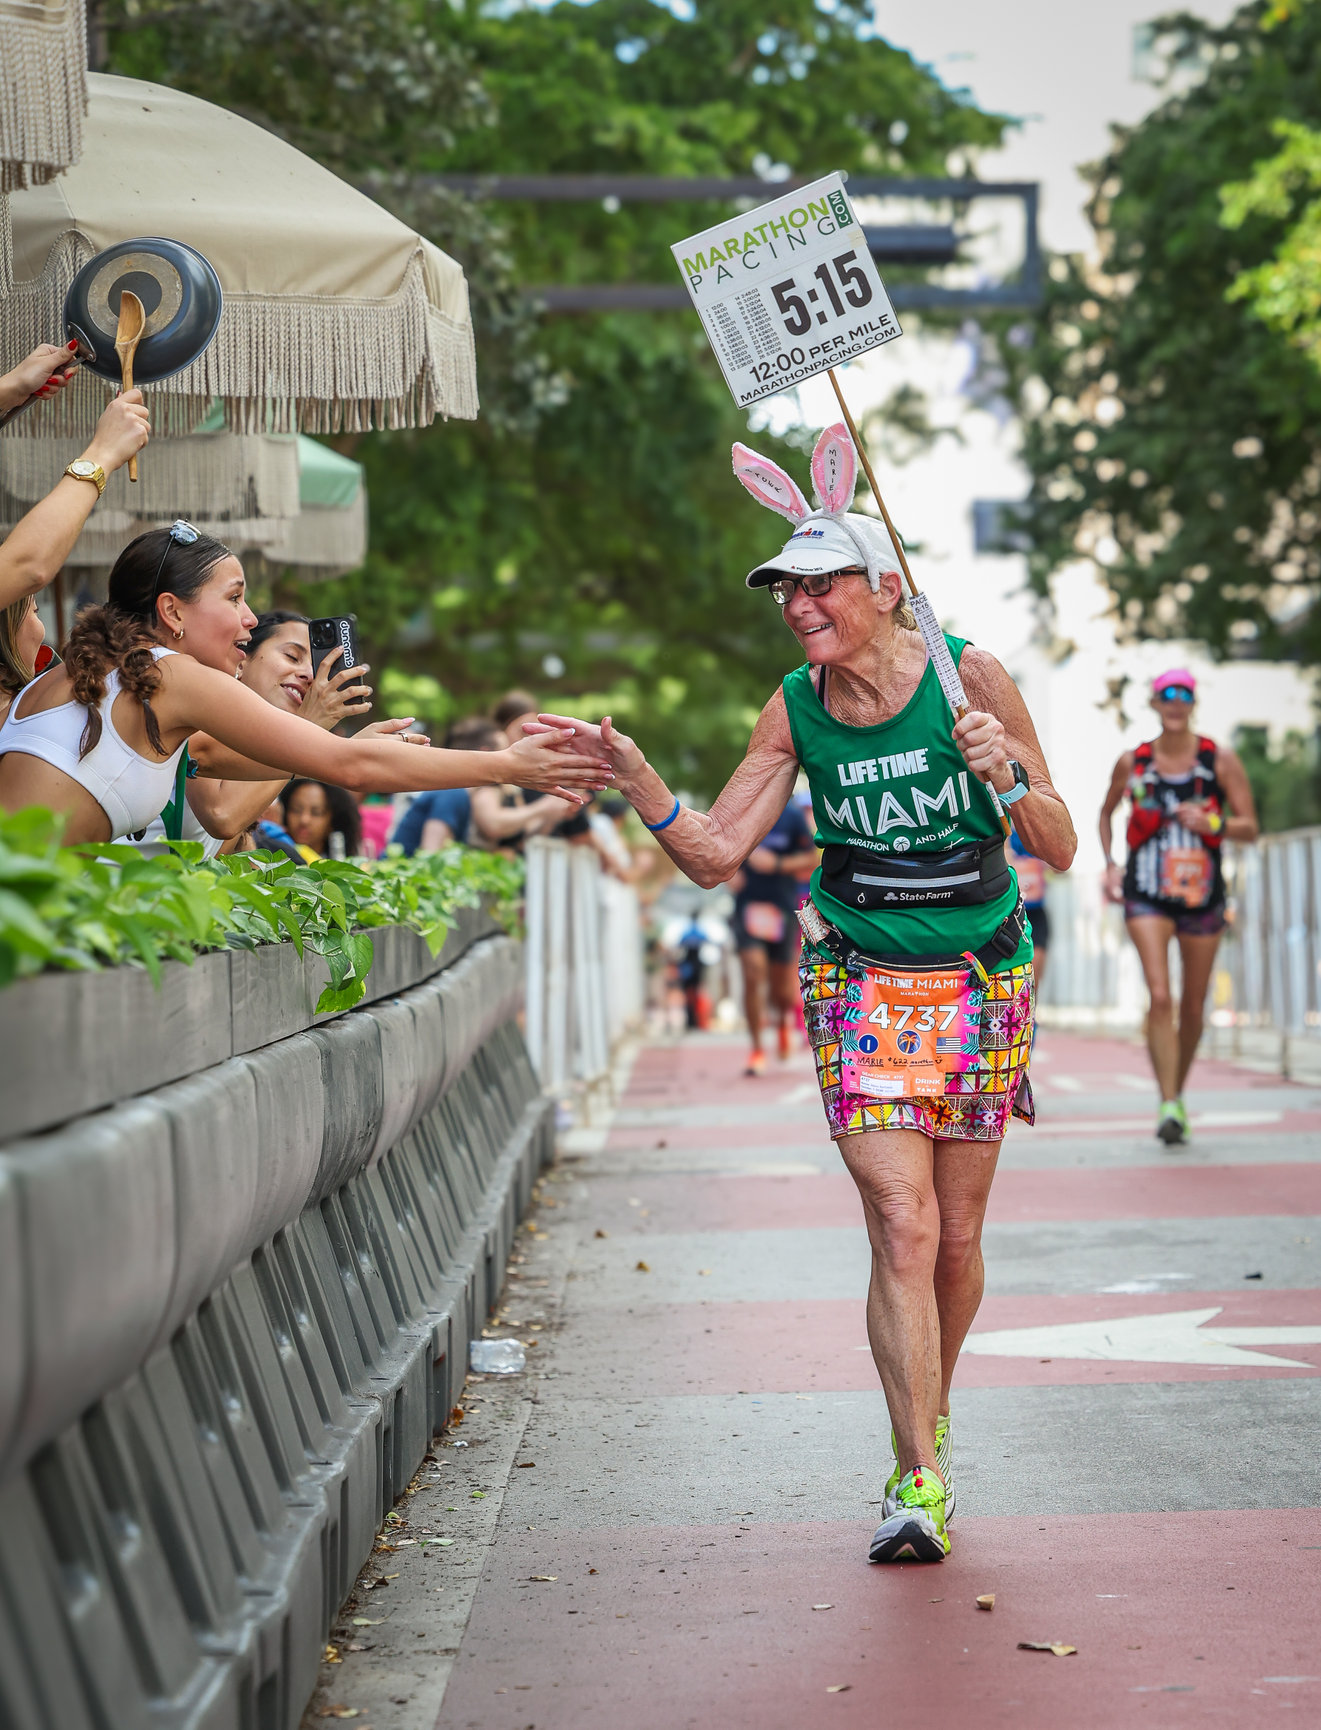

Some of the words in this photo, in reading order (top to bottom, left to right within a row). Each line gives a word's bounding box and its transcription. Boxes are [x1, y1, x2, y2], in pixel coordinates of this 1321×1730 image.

[683, 198, 829, 276] MARATHON
[690, 216, 836, 294] PACING
[771, 250, 872, 336] 5:15
[740, 327, 896, 402] MARATHONPACING.COM
[749, 347, 805, 383] 12:00
[808, 335, 846, 359] PER
[848, 314, 891, 338] MILE
[828, 449, 837, 491] MARIE
[910, 595, 928, 607] PACE
[915, 603, 930, 613] 5:15
[822, 771, 971, 837] MIAMI
[846, 837, 889, 852] MARATHON
[915, 834, 936, 846] AND
[938, 822, 959, 840] HALF
[916, 979, 958, 990] MIAMI
[867, 1002, 960, 1032] 4737
[857, 1057, 884, 1066] MARIE
[915, 1077, 941, 1085] DRINK
